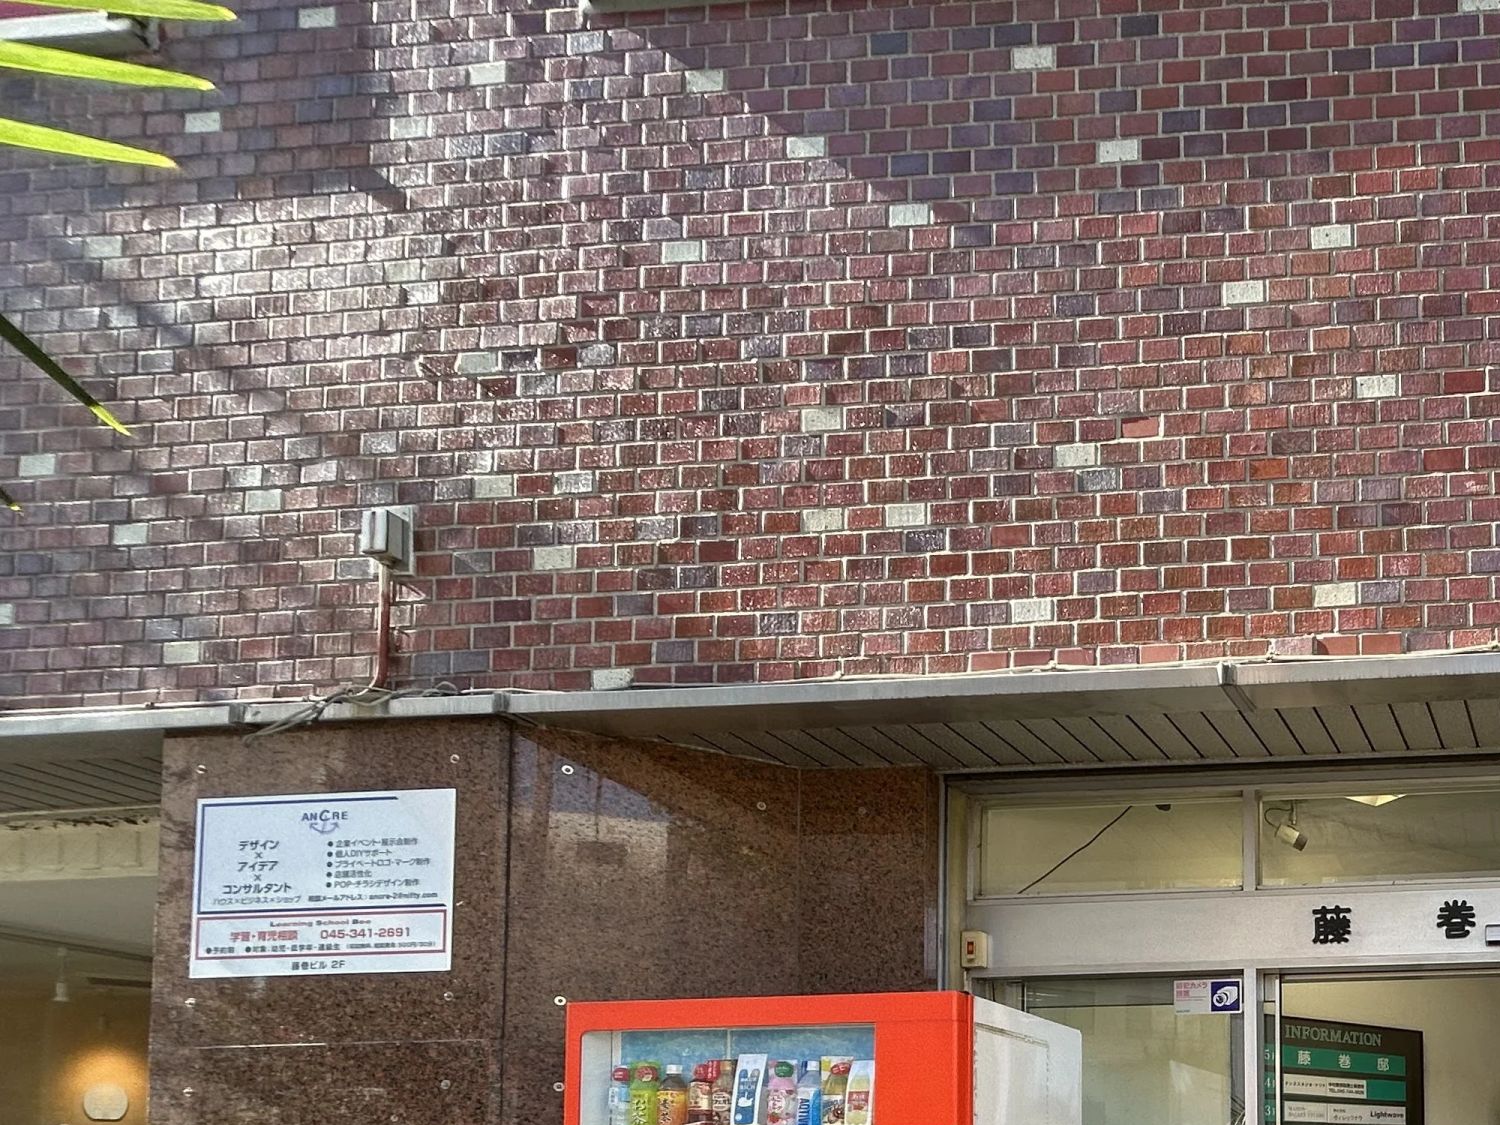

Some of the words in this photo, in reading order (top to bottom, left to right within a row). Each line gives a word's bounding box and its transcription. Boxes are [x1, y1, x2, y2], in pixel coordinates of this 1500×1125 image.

[301, 809, 349, 822] ANCRE
[238, 840, 280, 851] デザイン
[238, 861, 279, 872] アイデア
[222, 882, 292, 894] コンサルタント
[320, 927, 411, 939] 045-341-2691
[1285, 1024, 1382, 1047] INFORMATION
[1370, 1110, 1404, 1119] Lightwave
